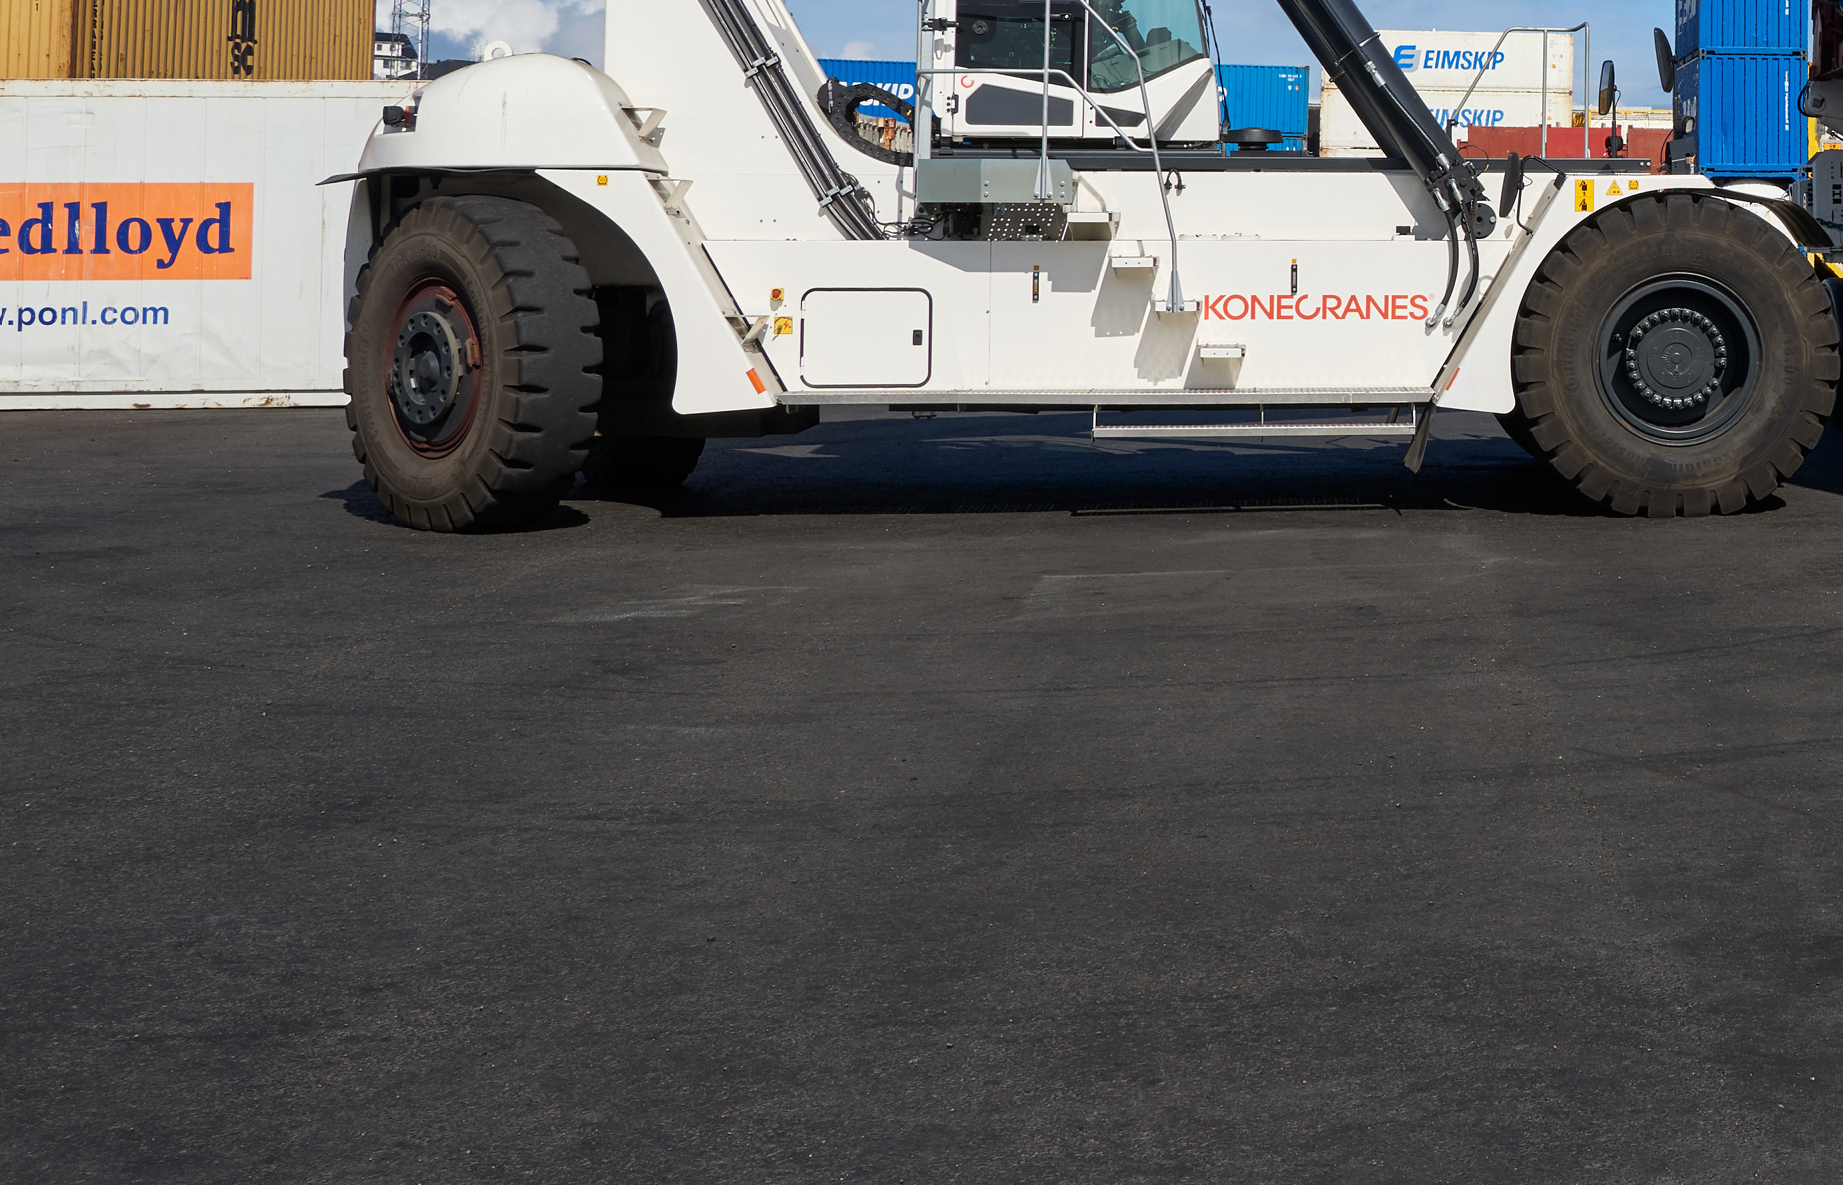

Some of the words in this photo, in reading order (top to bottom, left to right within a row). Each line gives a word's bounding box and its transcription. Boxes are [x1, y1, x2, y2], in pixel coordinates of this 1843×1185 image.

[1423, 50, 1505, 70] EIMSKIP
[0, 300, 170, 333] .ponl.com
[1204, 293, 1429, 321] KONECRANES
